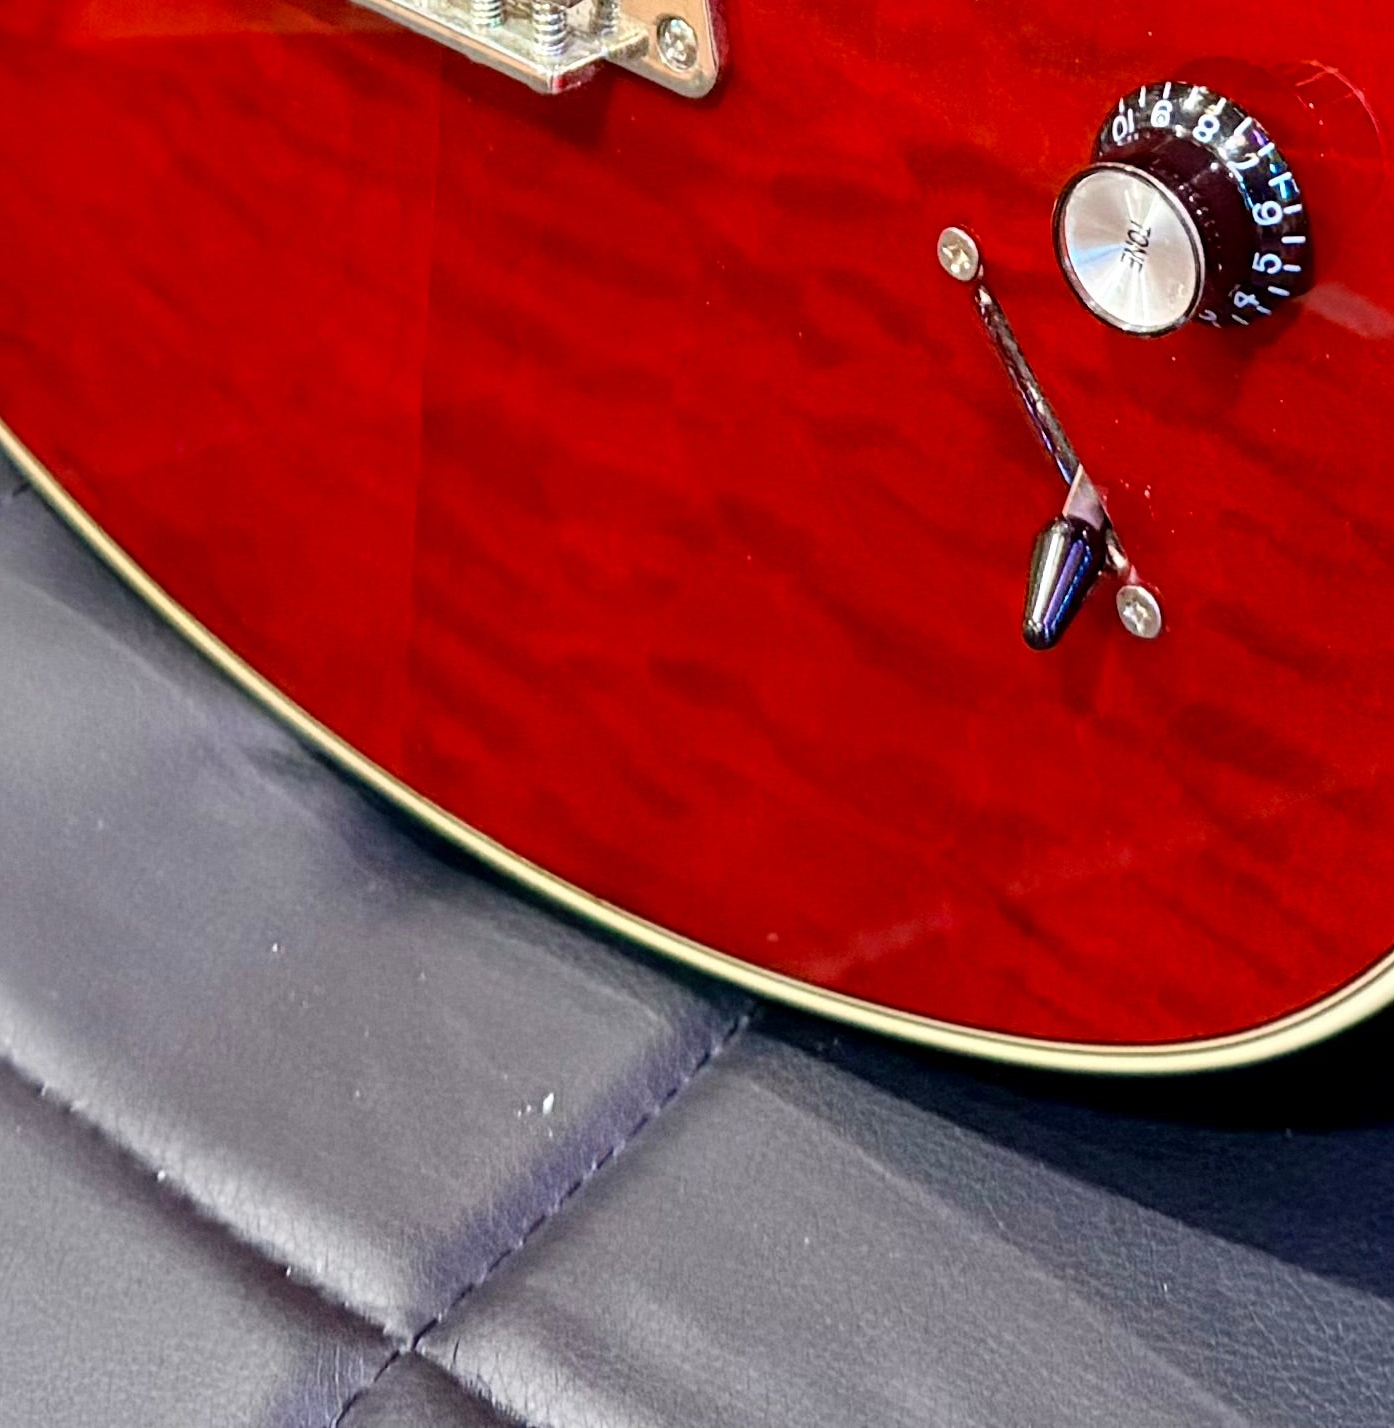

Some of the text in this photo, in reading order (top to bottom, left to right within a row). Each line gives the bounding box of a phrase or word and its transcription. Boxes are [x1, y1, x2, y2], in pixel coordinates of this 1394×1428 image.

[1252, 200, 1285, 227] 6
[1120, 218, 1153, 274] TONE
[1252, 251, 1283, 275] 5
[1233, 289, 1260, 309] 4
